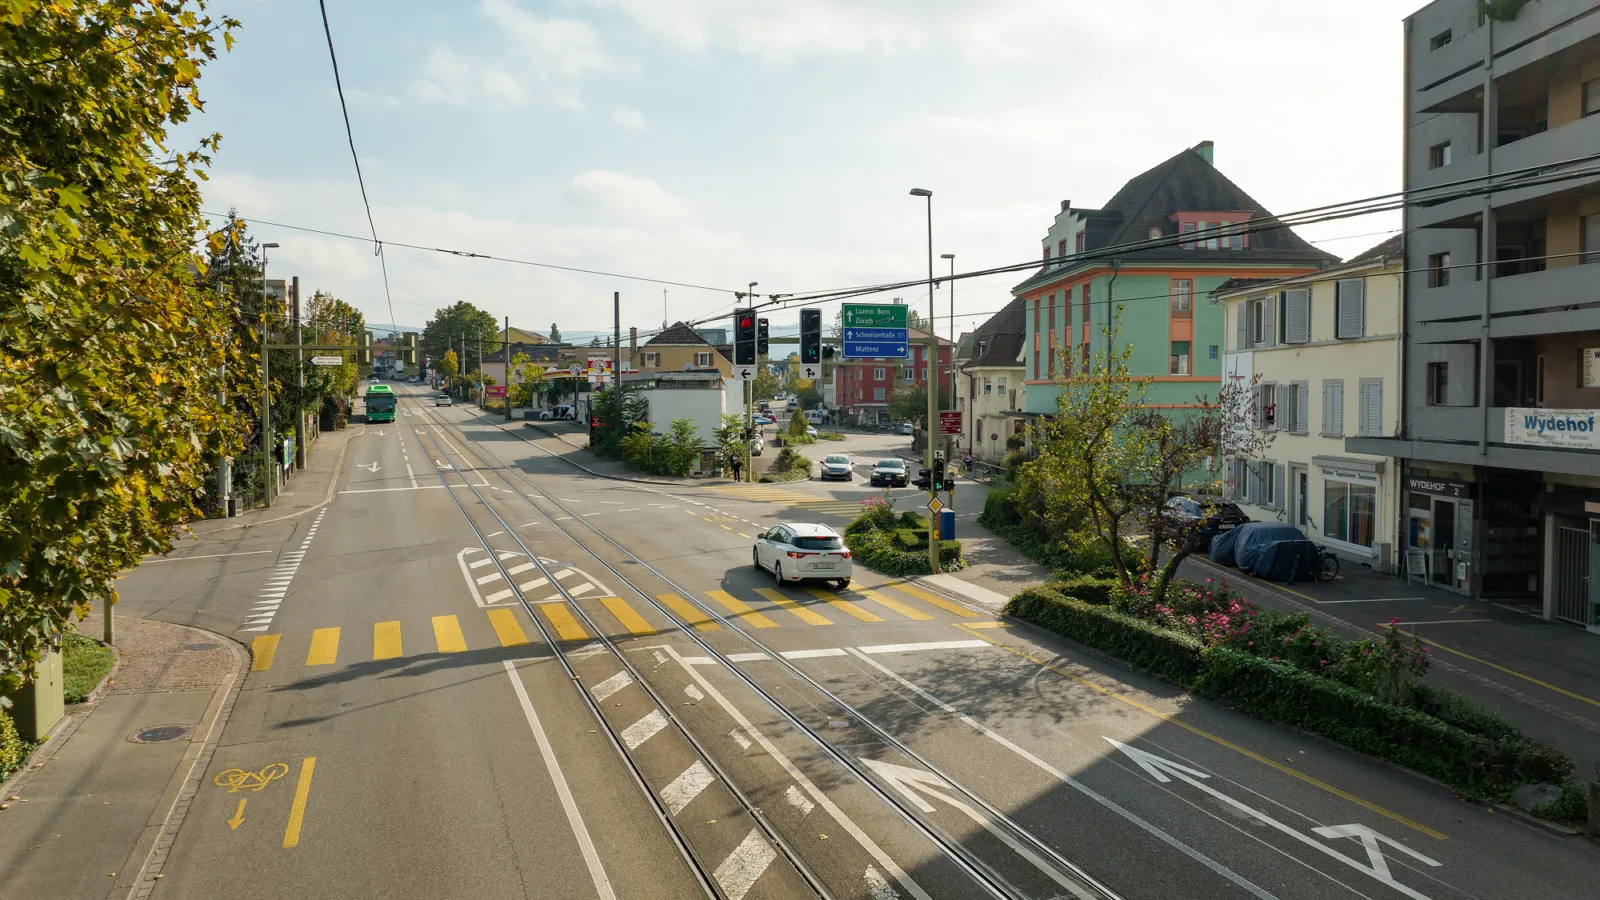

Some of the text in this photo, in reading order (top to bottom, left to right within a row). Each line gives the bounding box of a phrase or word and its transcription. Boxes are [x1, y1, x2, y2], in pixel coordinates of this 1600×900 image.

[855, 331, 895, 339] Schweizerhalle
[1533, 409, 1595, 419] Praxisgemeinschaft
[1524, 415, 1595, 434] Wydehof
[1357, 473, 1378, 482] Sanieren
[1409, 479, 1446, 492] WYDEHOF
[1454, 488, 1460, 496] 2
